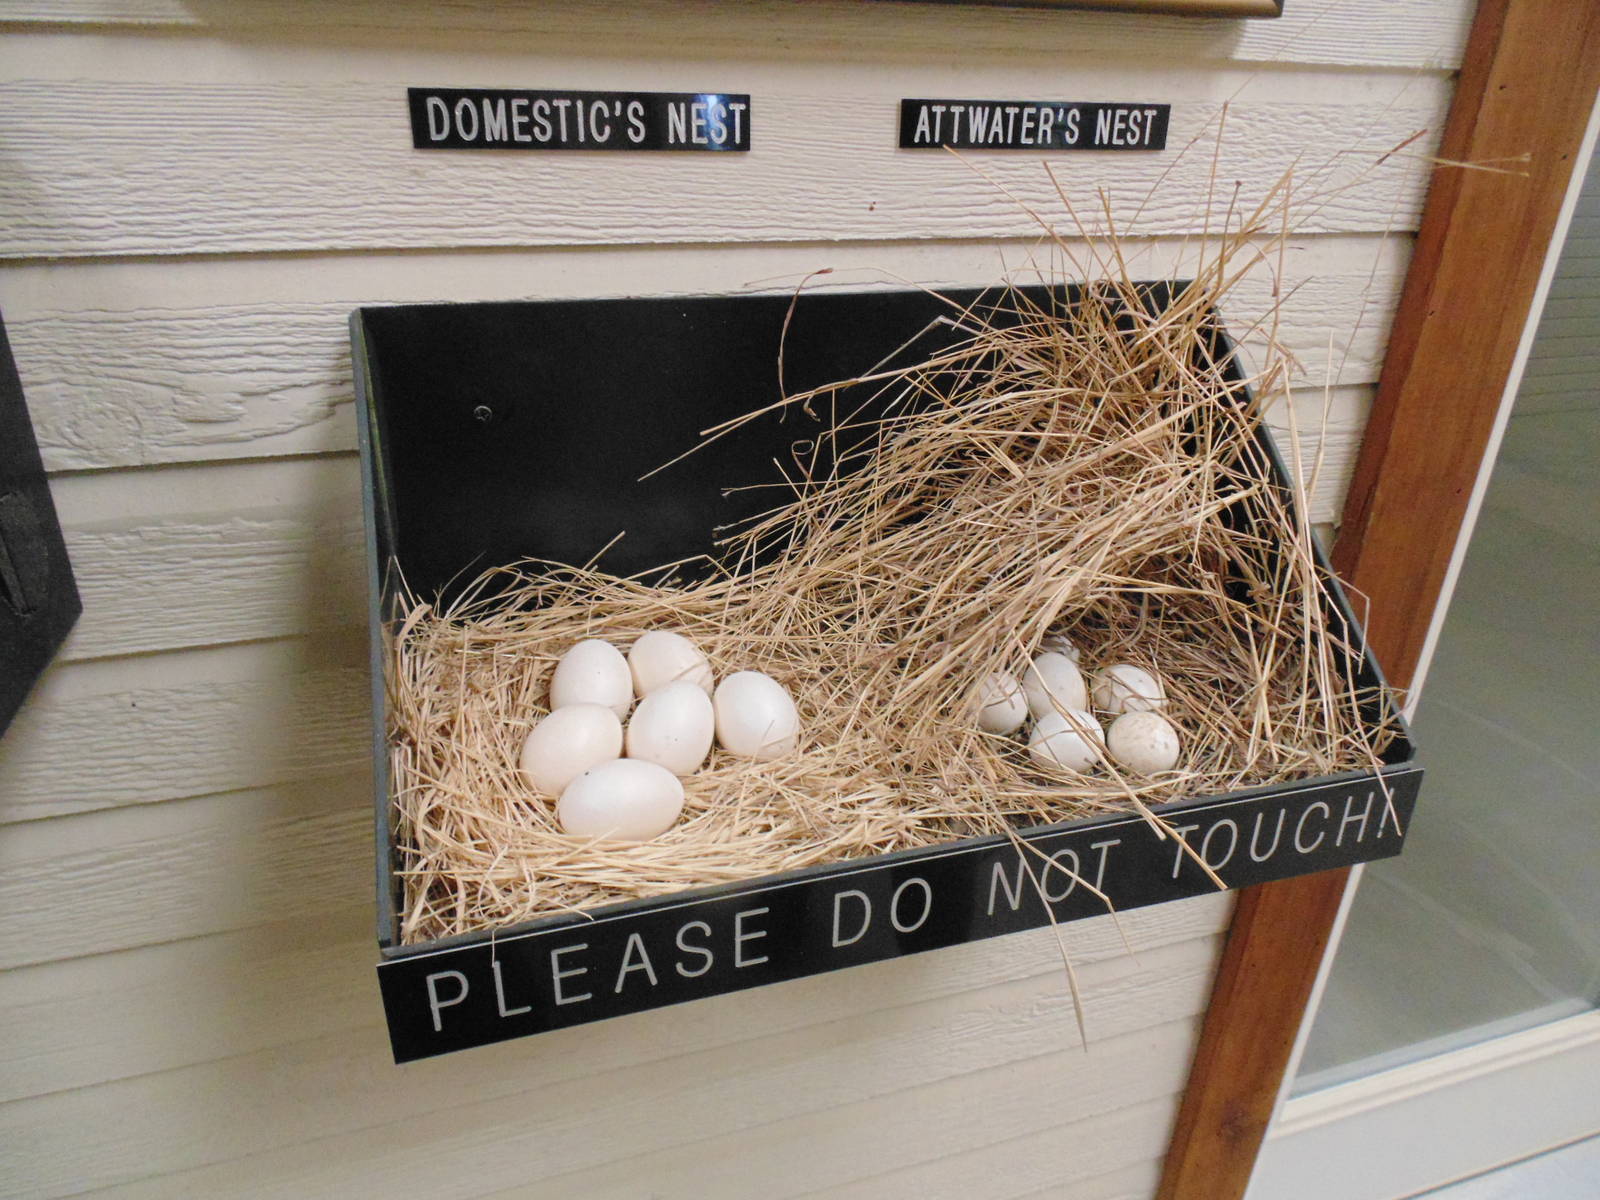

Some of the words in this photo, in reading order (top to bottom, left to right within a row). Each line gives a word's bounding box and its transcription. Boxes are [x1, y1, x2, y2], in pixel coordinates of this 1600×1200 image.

[426, 97, 646, 143] DOMESTIC'S
[667, 101, 746, 145] NEST
[913, 105, 1081, 144] ATTWATER'S
[1094, 109, 1158, 146] NEST
[425, 906, 769, 1032] PLEASE
[831, 877, 932, 948] DO
[986, 838, 1121, 915] NOT
[1171, 787, 1396, 879] TOUCH!
